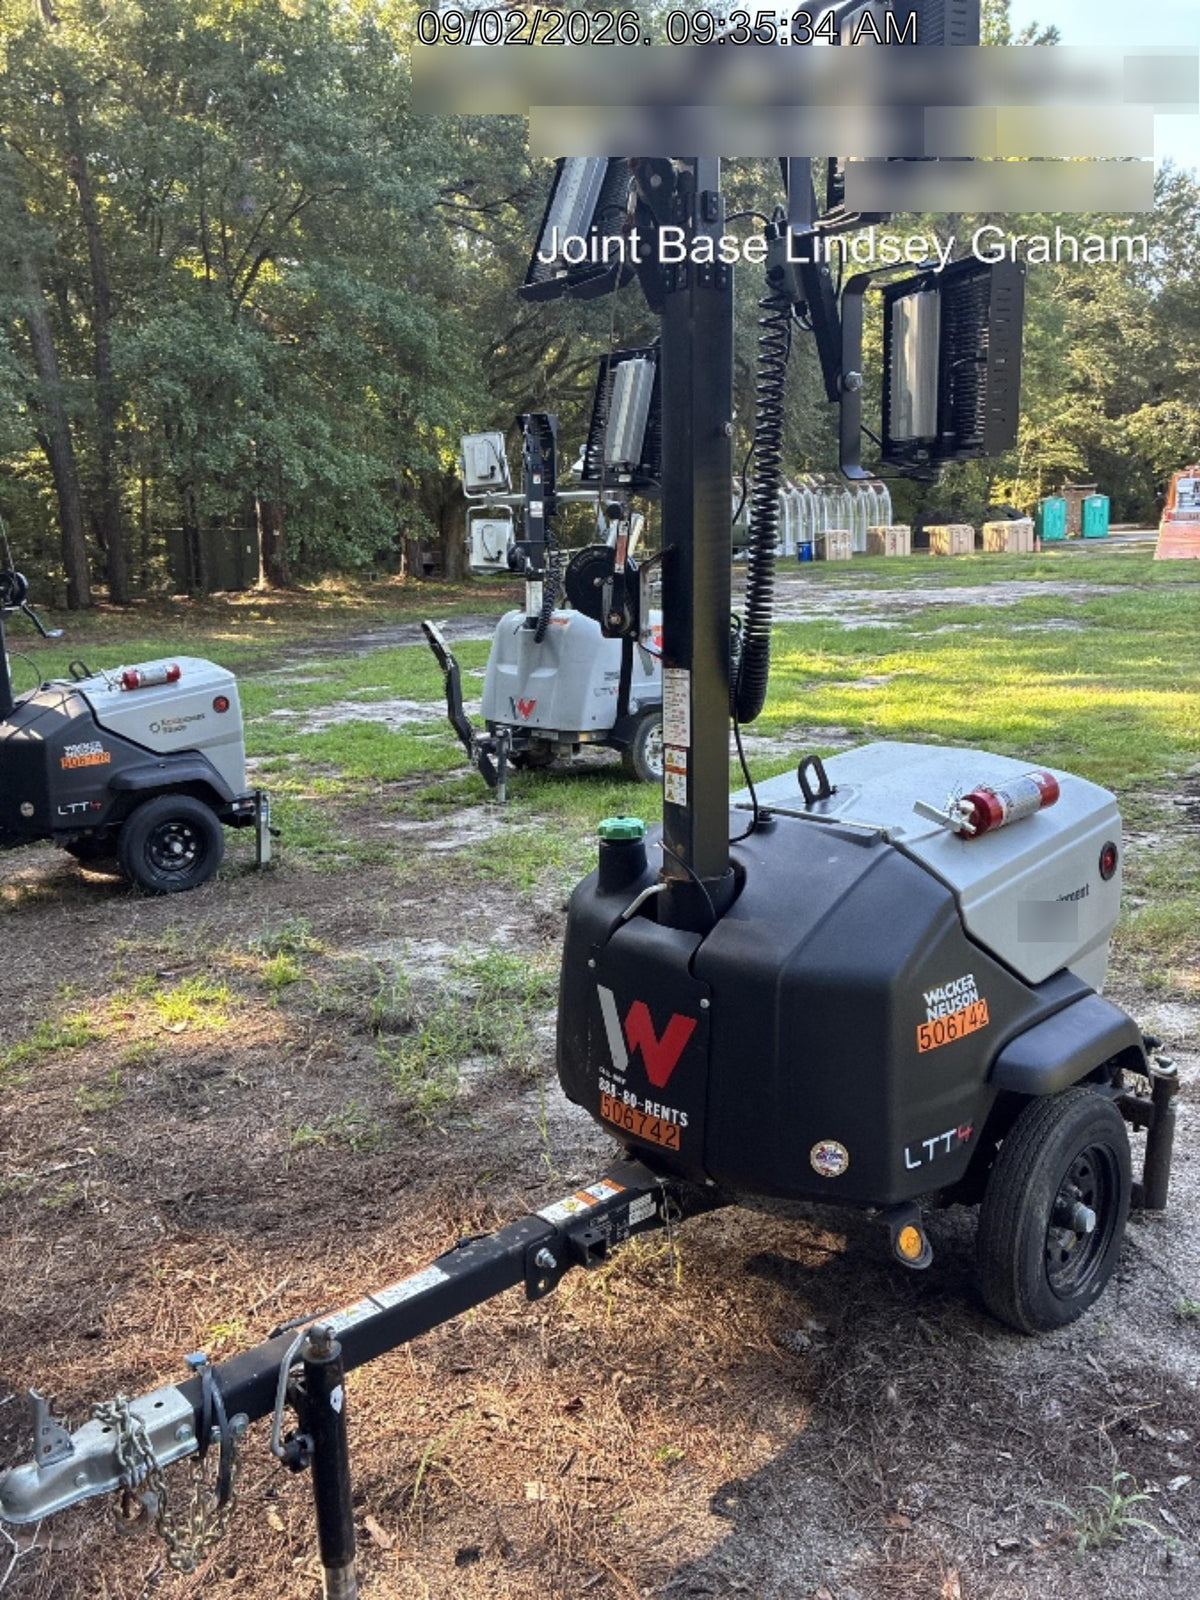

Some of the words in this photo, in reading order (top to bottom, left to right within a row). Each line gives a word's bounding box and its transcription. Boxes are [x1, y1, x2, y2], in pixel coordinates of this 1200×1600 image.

[922, 974, 976, 1007] WACKER
[926, 988, 979, 1023] NEUSON
[919, 1001, 987, 1050] 506742
[602, 1094, 677, 1147] 506742
[904, 1125, 973, 1169] LTT4
